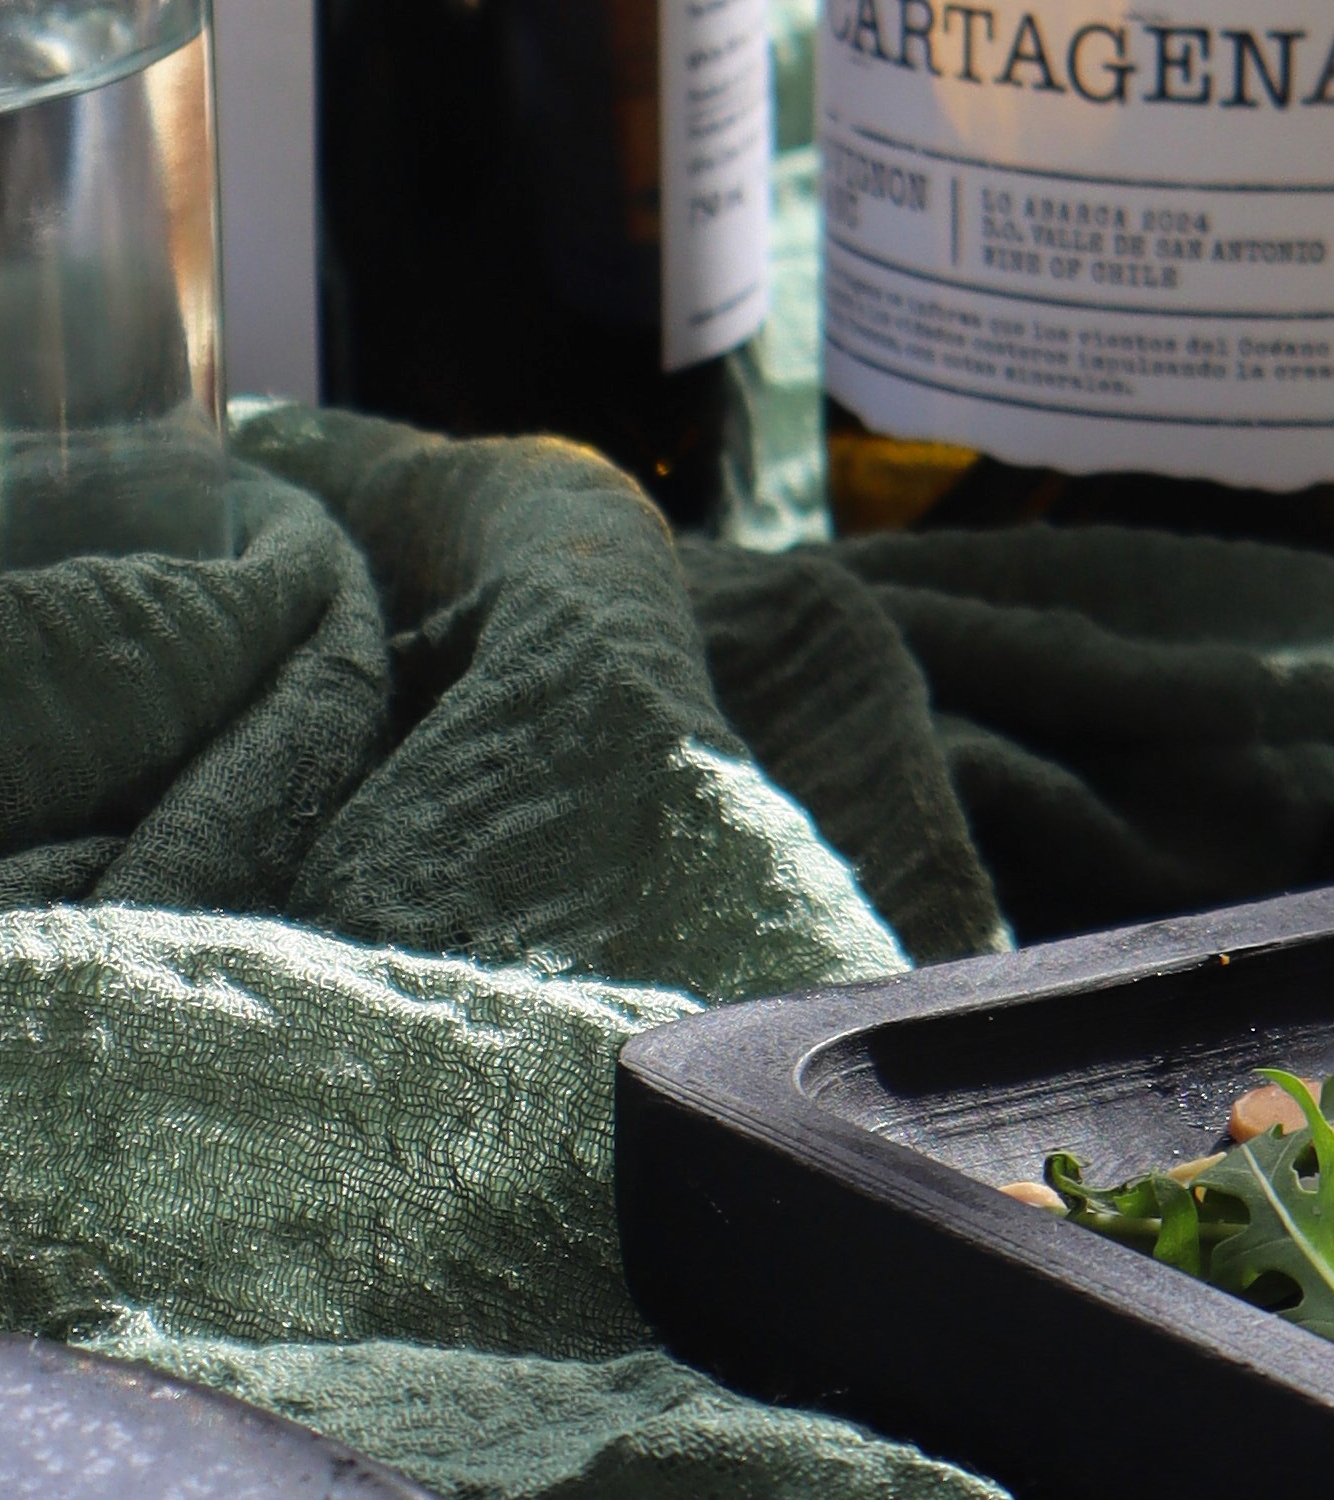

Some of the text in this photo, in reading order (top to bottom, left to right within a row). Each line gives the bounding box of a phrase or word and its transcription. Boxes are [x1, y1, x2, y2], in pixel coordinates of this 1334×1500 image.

[1032, 223, 1105, 254] VALLE
[1114, 233, 1145, 257] DE
[1154, 237, 1203, 262] SAN
[1210, 238, 1326, 264] ANTONIO
[1048, 255, 1082, 280] OF
[1090, 261, 1178, 288] CHILE
